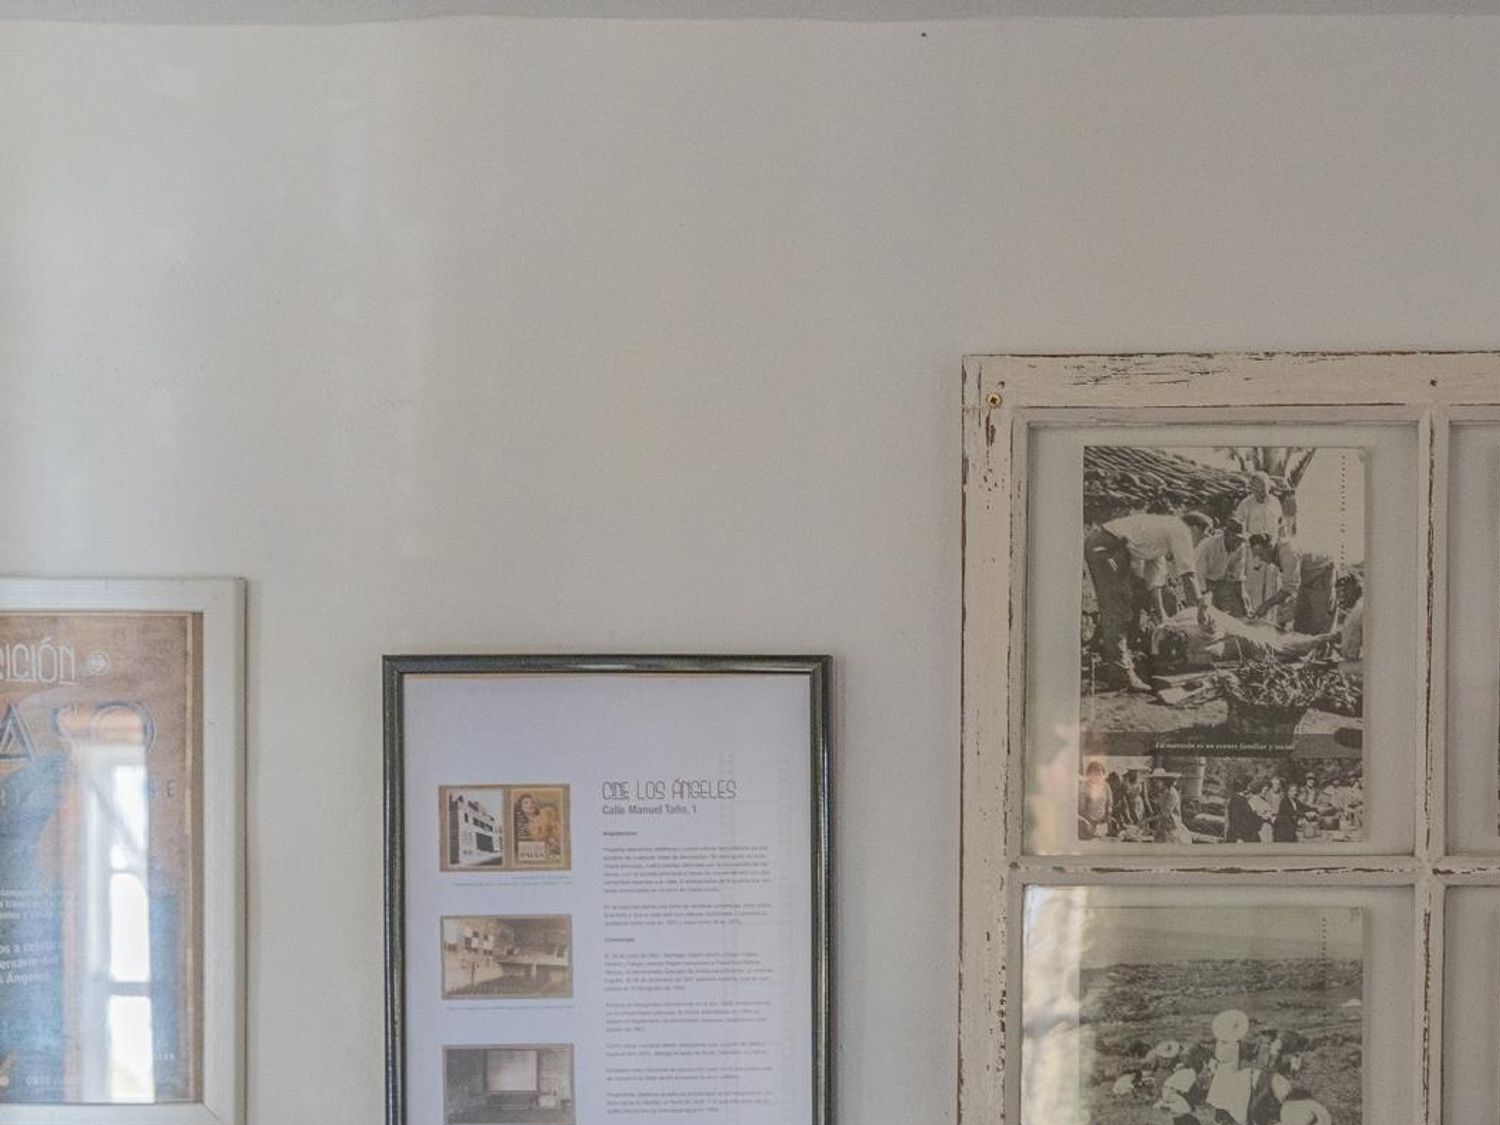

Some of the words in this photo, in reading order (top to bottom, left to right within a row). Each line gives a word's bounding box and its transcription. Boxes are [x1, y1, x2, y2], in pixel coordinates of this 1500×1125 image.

[637, 779, 666, 801] LOS
[602, 804, 626, 815] Calle
[628, 803, 663, 815] Manuel
